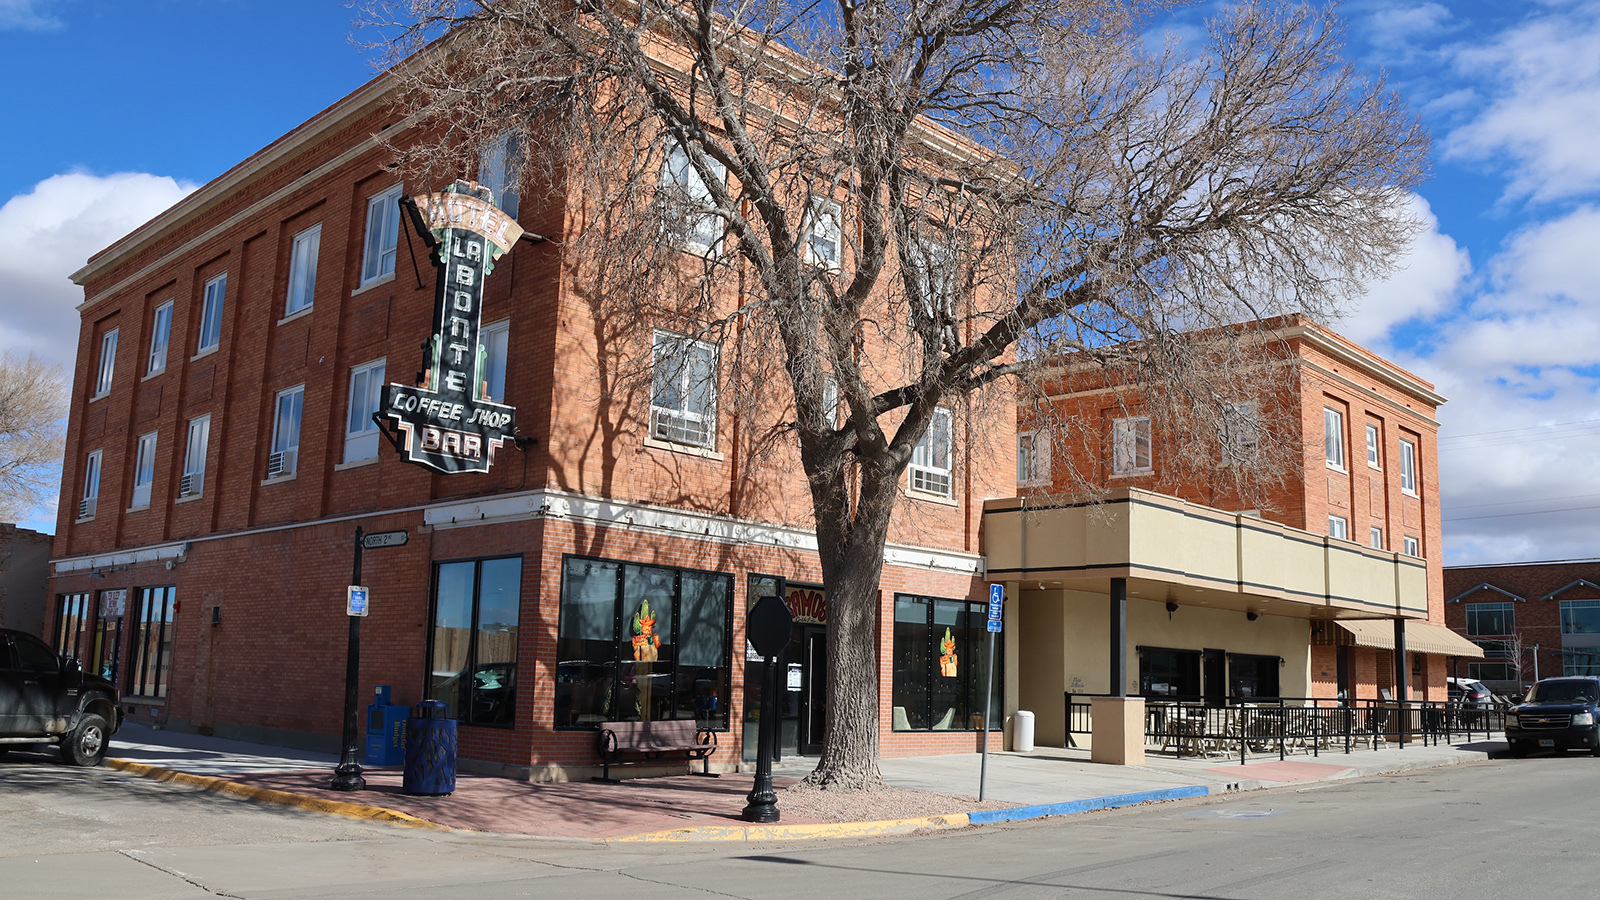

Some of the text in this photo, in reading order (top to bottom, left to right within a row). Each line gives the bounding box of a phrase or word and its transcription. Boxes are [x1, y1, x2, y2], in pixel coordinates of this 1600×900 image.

[424, 197, 510, 247] HOTEL
[445, 236, 481, 392] LA BONTE
[392, 393, 512, 429] COFFEE SHOP
[420, 427, 482, 458] BAR
[365, 535, 383, 546] NORTH
[392, 721, 401, 748] Budget
